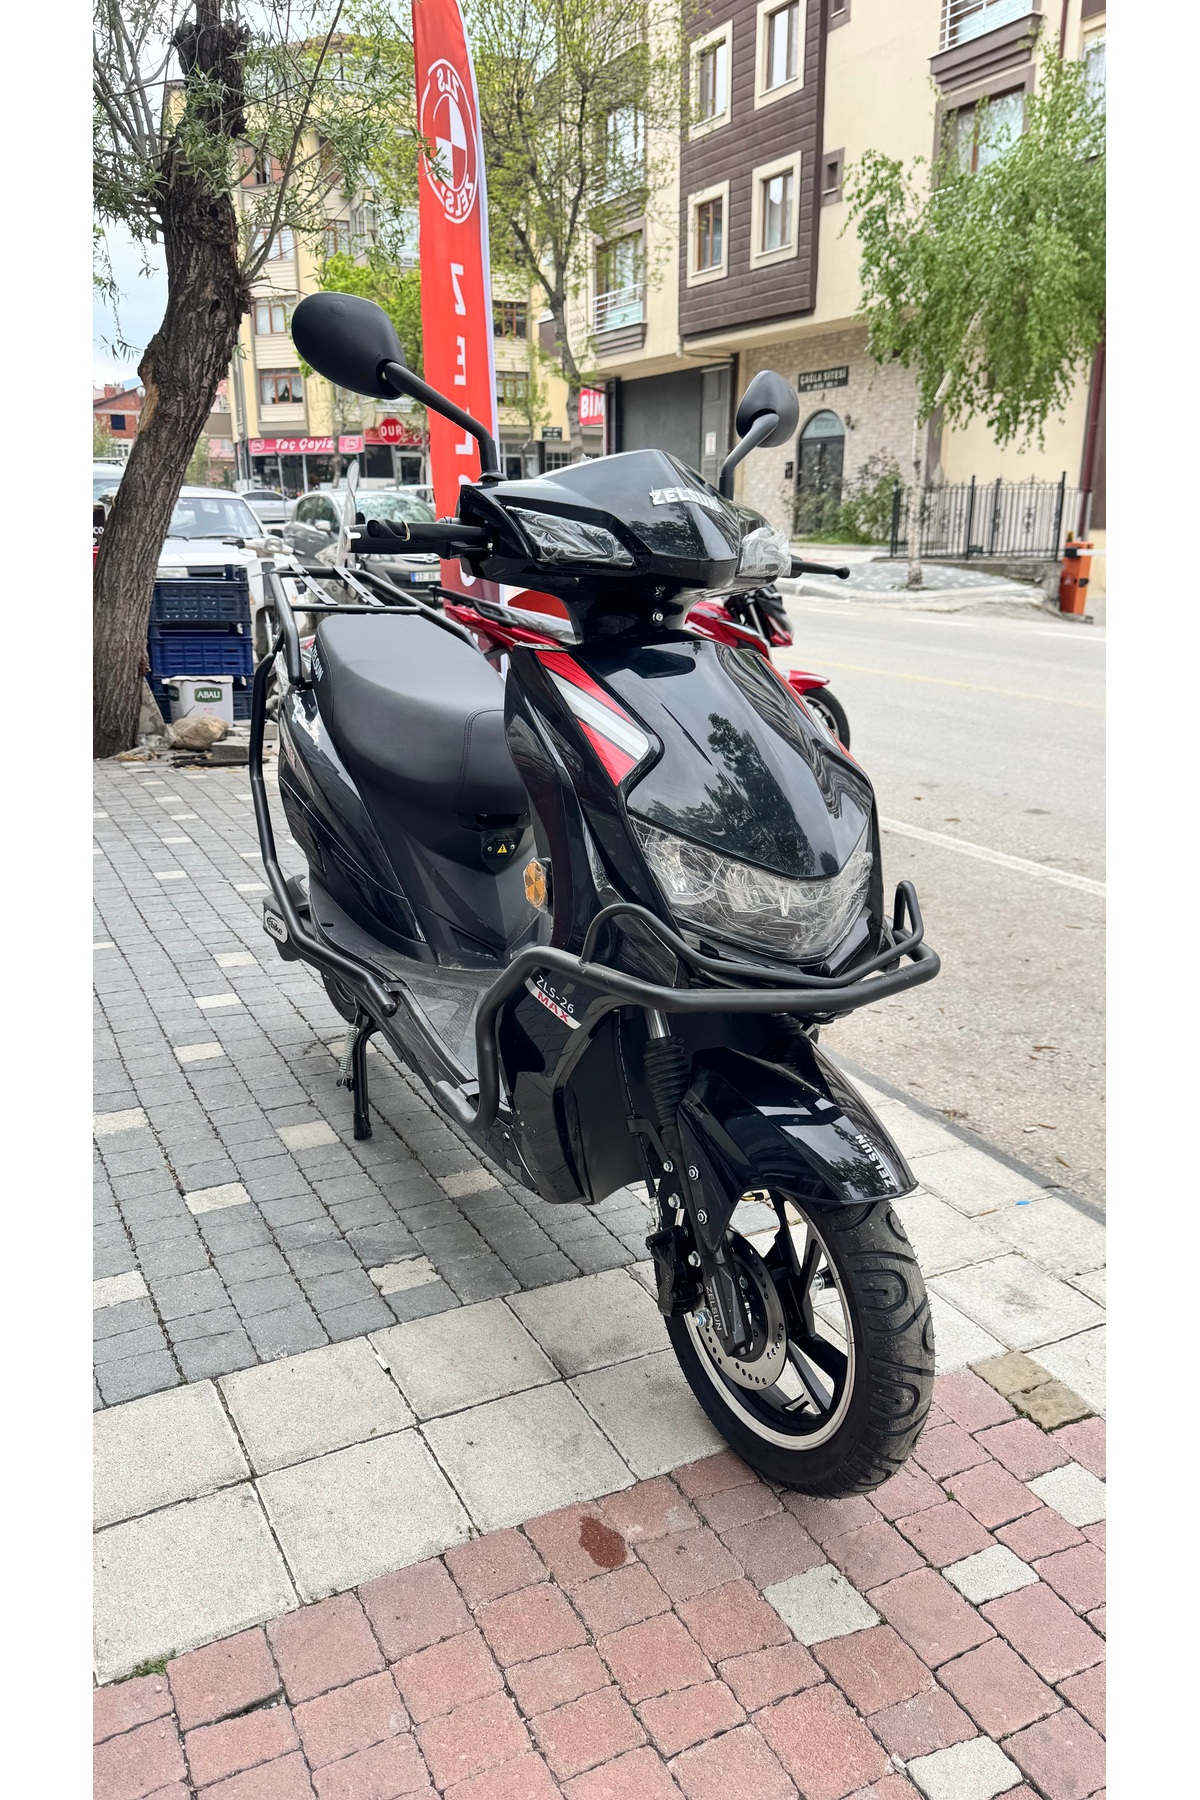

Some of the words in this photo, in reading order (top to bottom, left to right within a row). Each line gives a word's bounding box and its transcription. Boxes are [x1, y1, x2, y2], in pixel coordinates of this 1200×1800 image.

[580, 391, 604, 419] BİM
[275, 438, 297, 451] Taç
[299, 437, 335, 451] Çeyiz
[380, 425, 403, 437] DUR
[536, 974, 575, 1014] ZLS-26
[537, 991, 569, 1023] MAX
[855, 1134, 896, 1188] ZELSUN
[705, 1285, 723, 1331] ZELSUN
